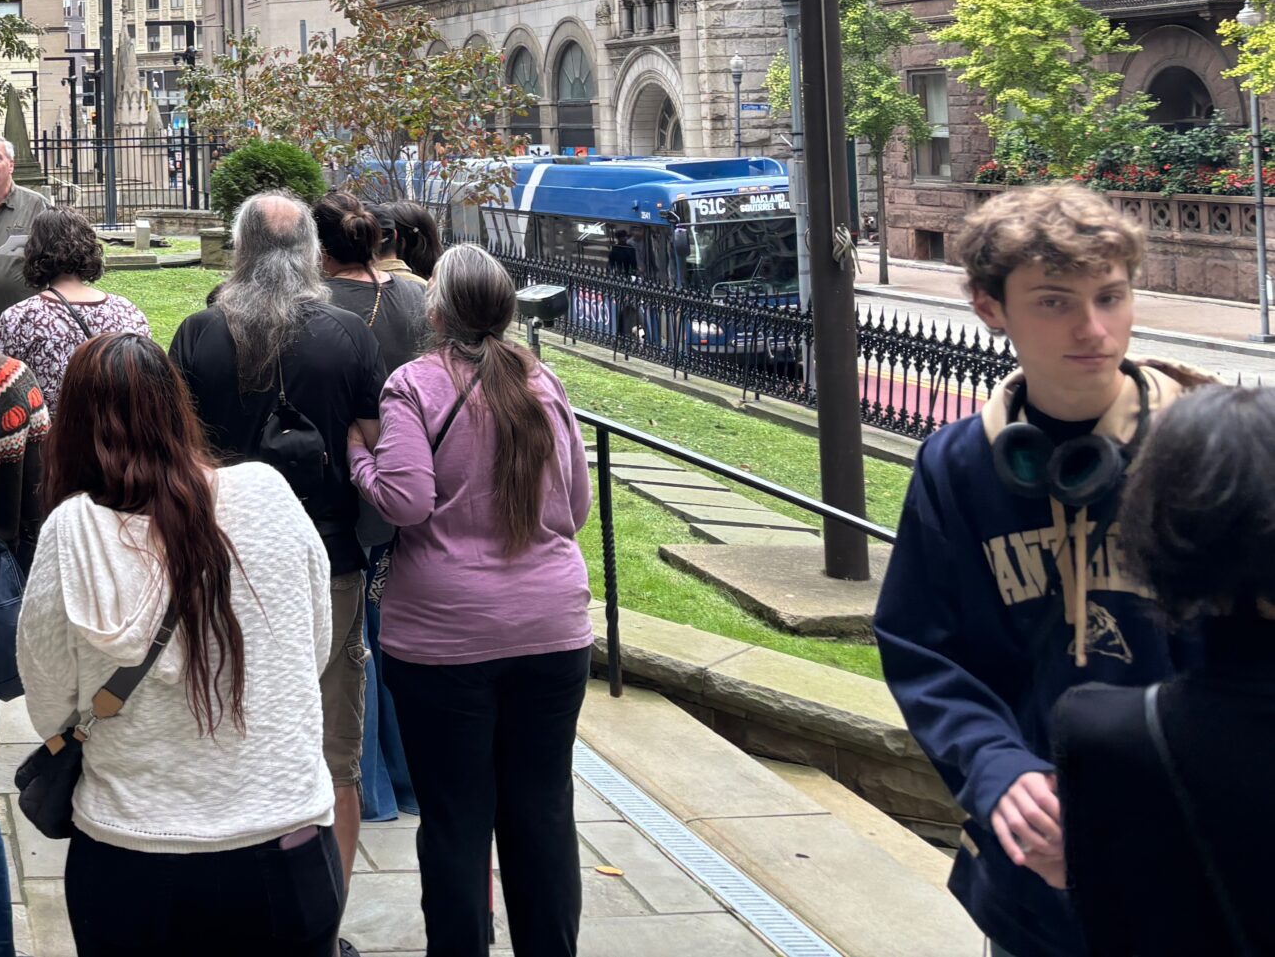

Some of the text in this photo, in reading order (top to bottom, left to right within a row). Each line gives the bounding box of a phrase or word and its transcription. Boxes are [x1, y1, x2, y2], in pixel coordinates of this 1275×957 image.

[750, 193, 785, 204] OAKLAND
[699, 197, 726, 215] 61C
[739, 202, 776, 213] SQUIRREL
